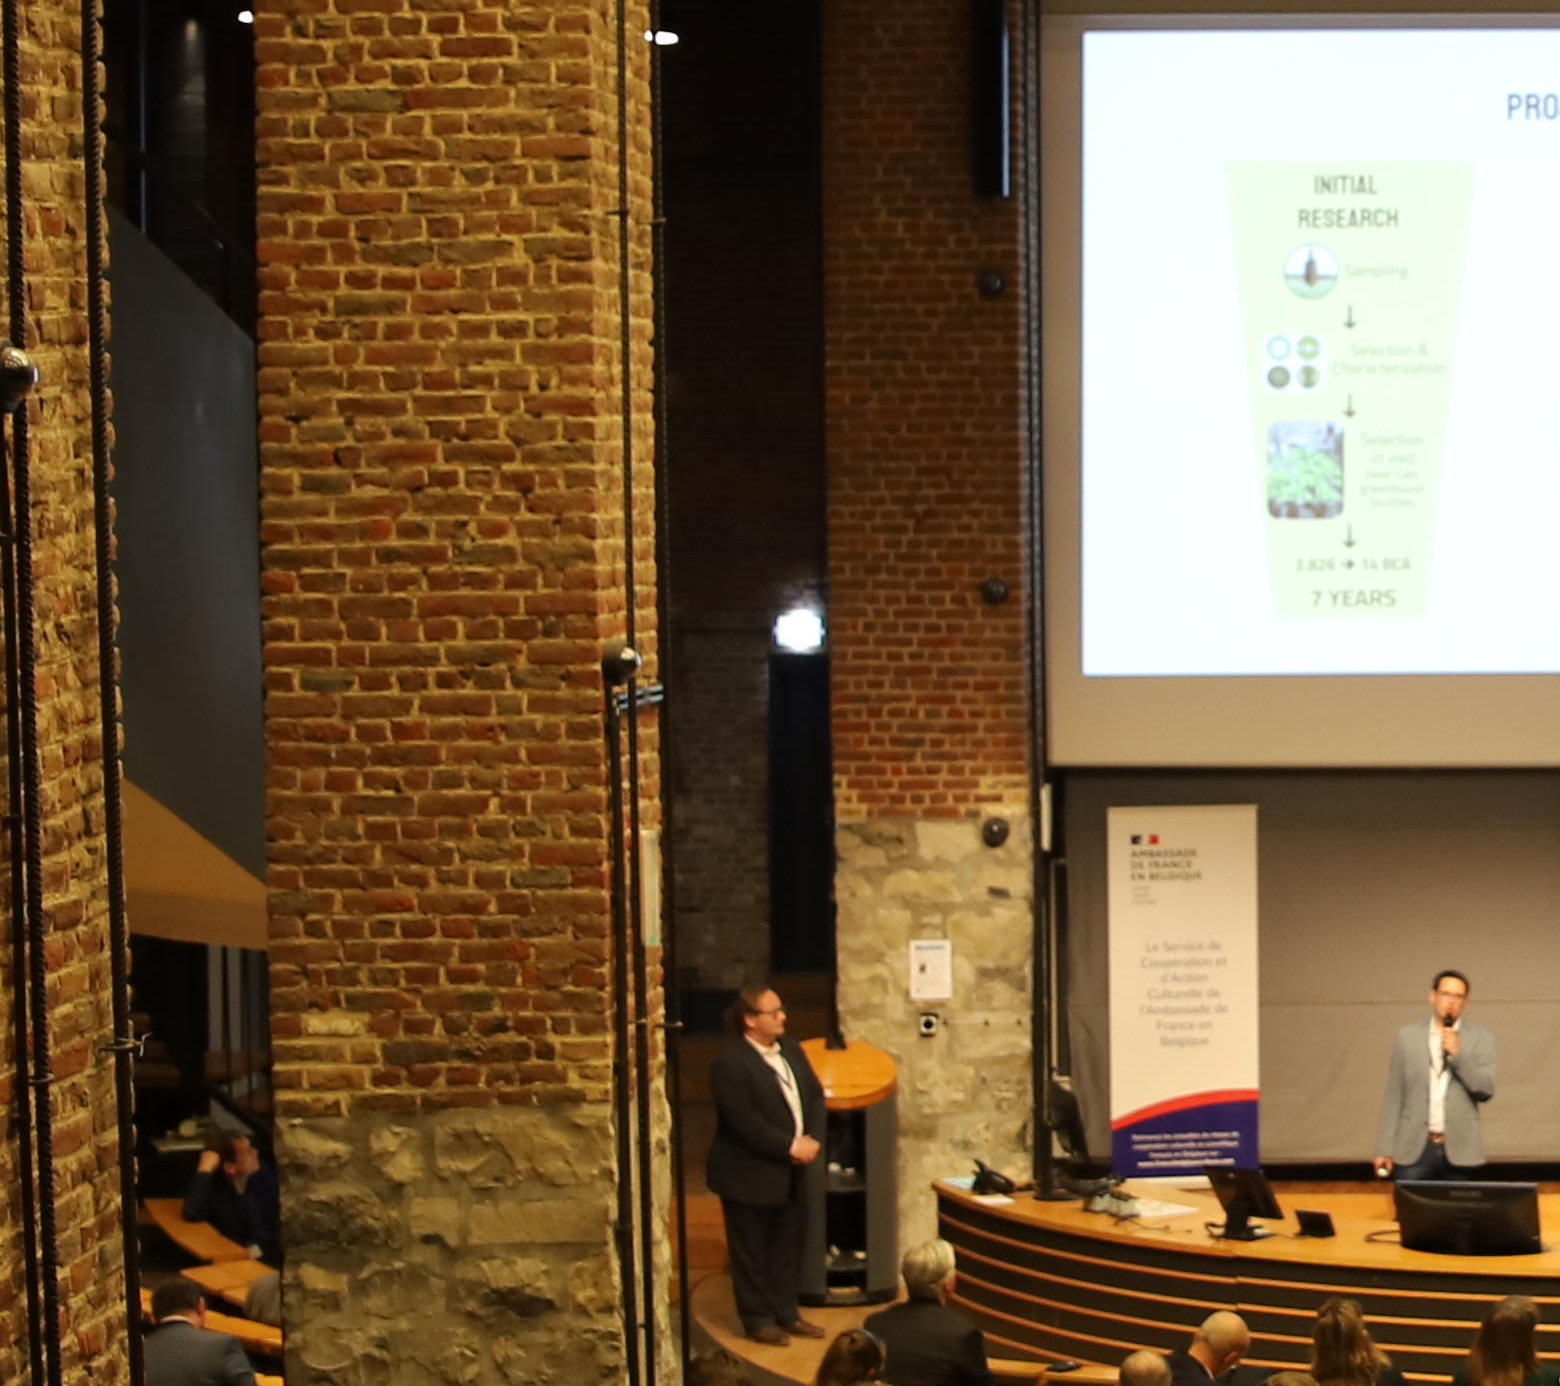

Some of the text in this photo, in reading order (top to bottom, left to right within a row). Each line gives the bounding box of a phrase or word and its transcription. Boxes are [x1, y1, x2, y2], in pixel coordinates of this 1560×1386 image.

[1313, 174, 1379, 195] INITIAL
[1297, 208, 1399, 229] RESEARCH
[1343, 263, 1409, 281] Sampling
[1349, 343, 1413, 357] Selection
[1332, 361, 1446, 375] Characterization
[1359, 433, 1424, 447] Selection
[1382, 558, 1412, 571] BCA
[1311, 589, 1397, 607] 7 YEARS
[1131, 849, 1197, 857] AMBASSADE
[1148, 859, 1193, 869] FRANCE
[1149, 871, 1202, 881] BELGIQUE
[1145, 940, 1222, 952] Le Service de
[1140, 957, 1227, 968] Coopération et
[1147, 988, 1221, 999] Culturelle de
[1215, 1004, 1229, 1014] de
[1156, 1019, 1213, 1030] France en
[1160, 1035, 1209, 1049] Belgique
